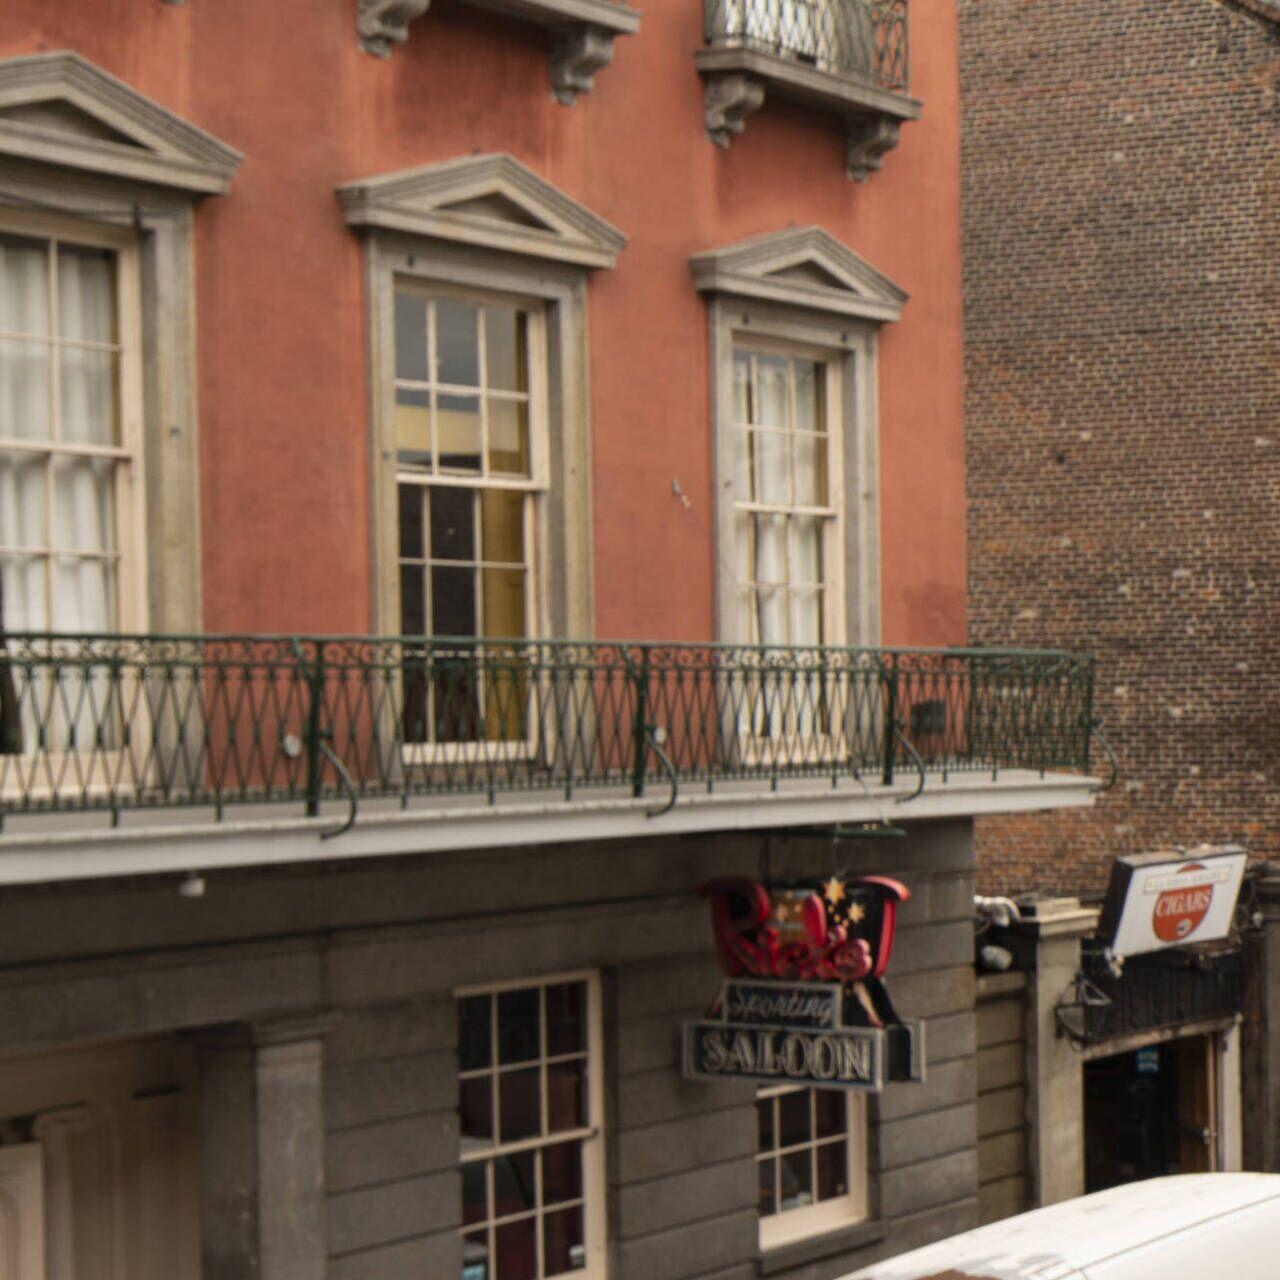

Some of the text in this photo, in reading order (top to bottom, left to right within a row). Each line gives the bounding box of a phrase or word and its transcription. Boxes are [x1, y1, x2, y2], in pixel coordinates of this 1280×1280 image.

[1156, 890, 1209, 917] CIGARS
[734, 987, 834, 1026] Sporting
[703, 1029, 871, 1080] SALOON
